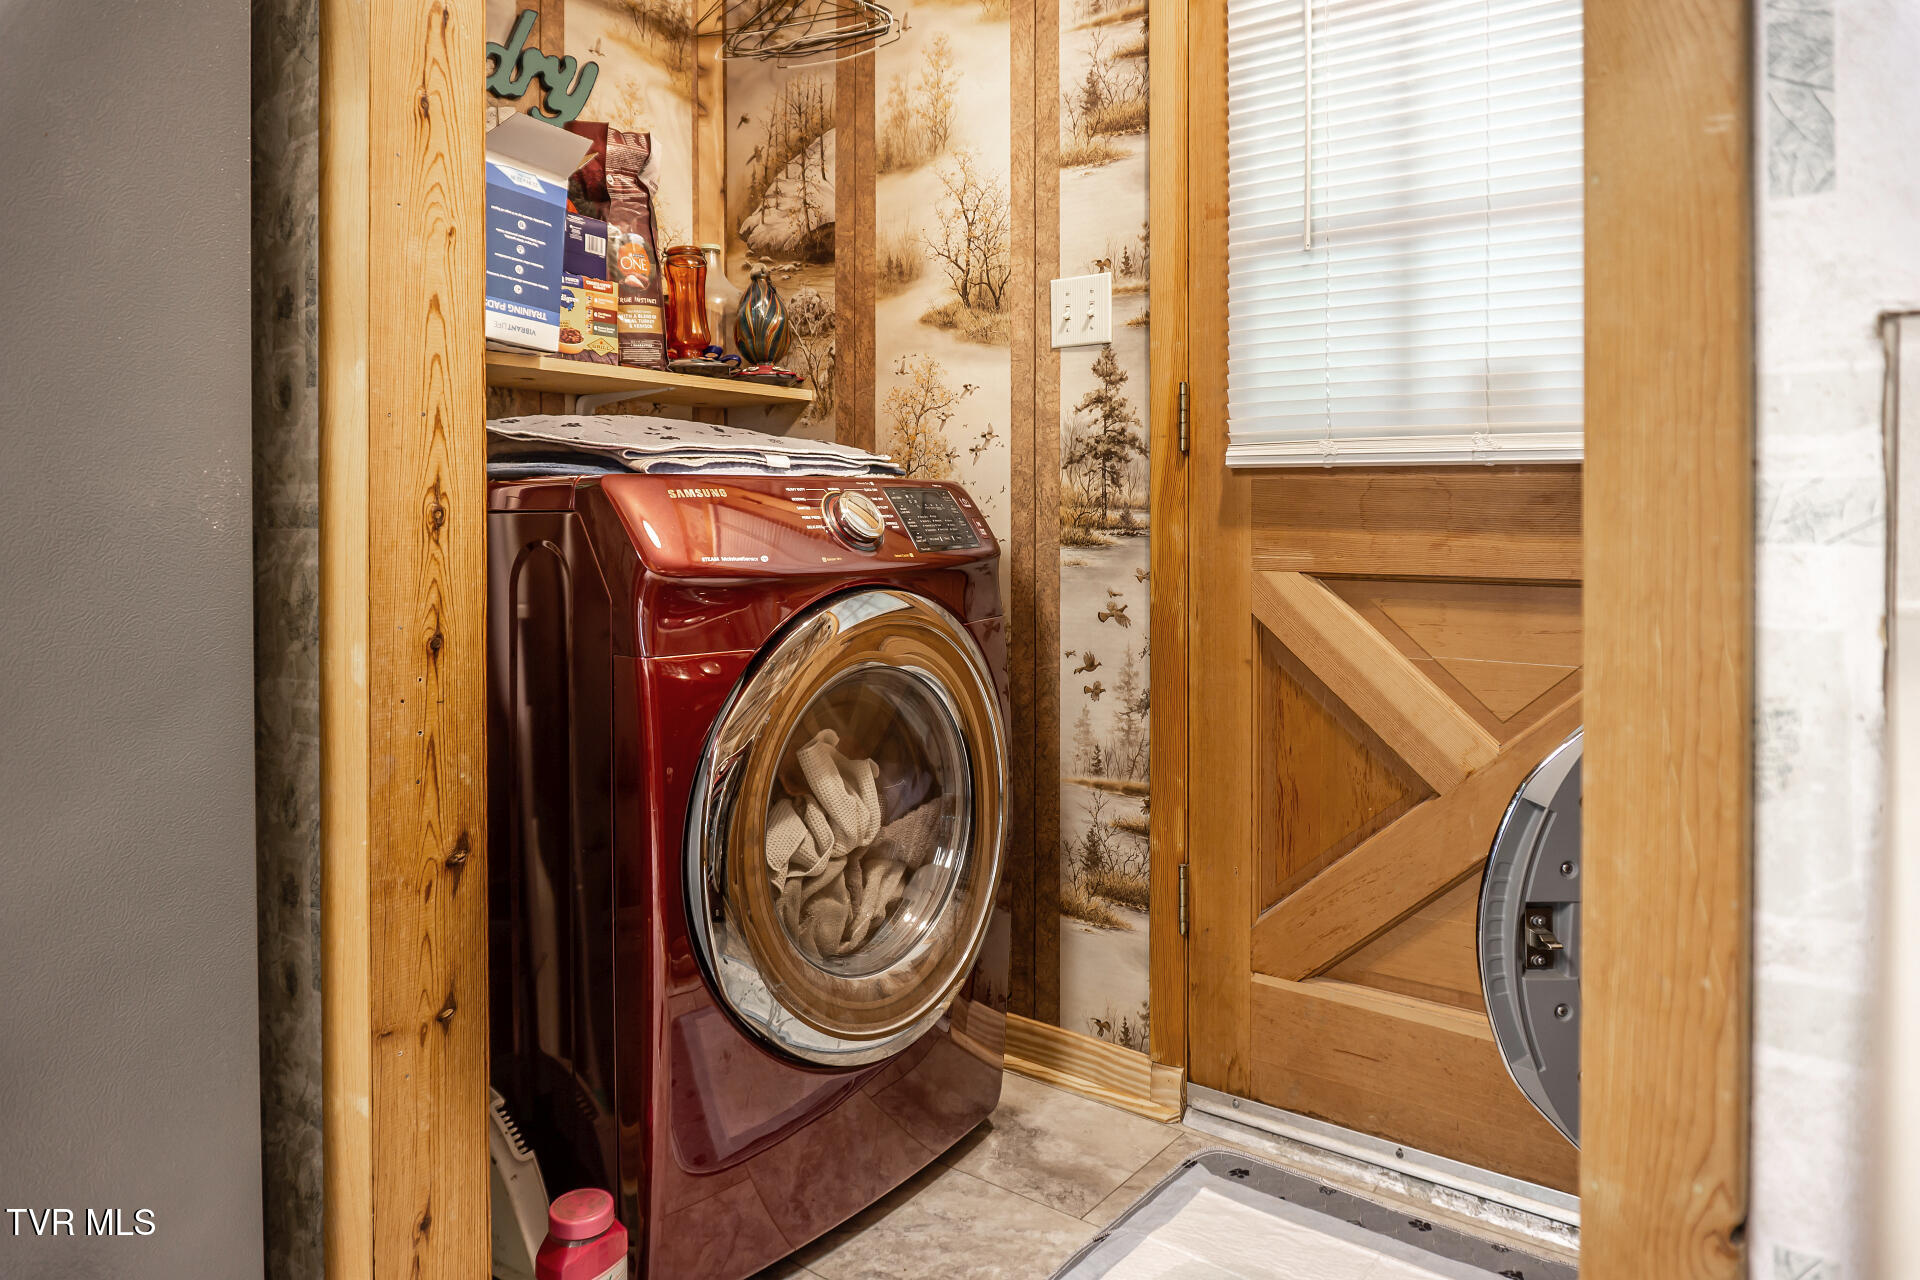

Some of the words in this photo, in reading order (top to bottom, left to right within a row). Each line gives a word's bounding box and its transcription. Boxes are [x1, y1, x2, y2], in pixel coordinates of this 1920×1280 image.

[620, 255, 648, 271] ONE
[486, 298, 507, 312] PAD
[507, 304, 548, 321] TRAINING
[493, 320, 508, 329] LIFE
[507, 323, 537, 336] VIBRANT
[667, 488, 728, 499] SAMSUNG
